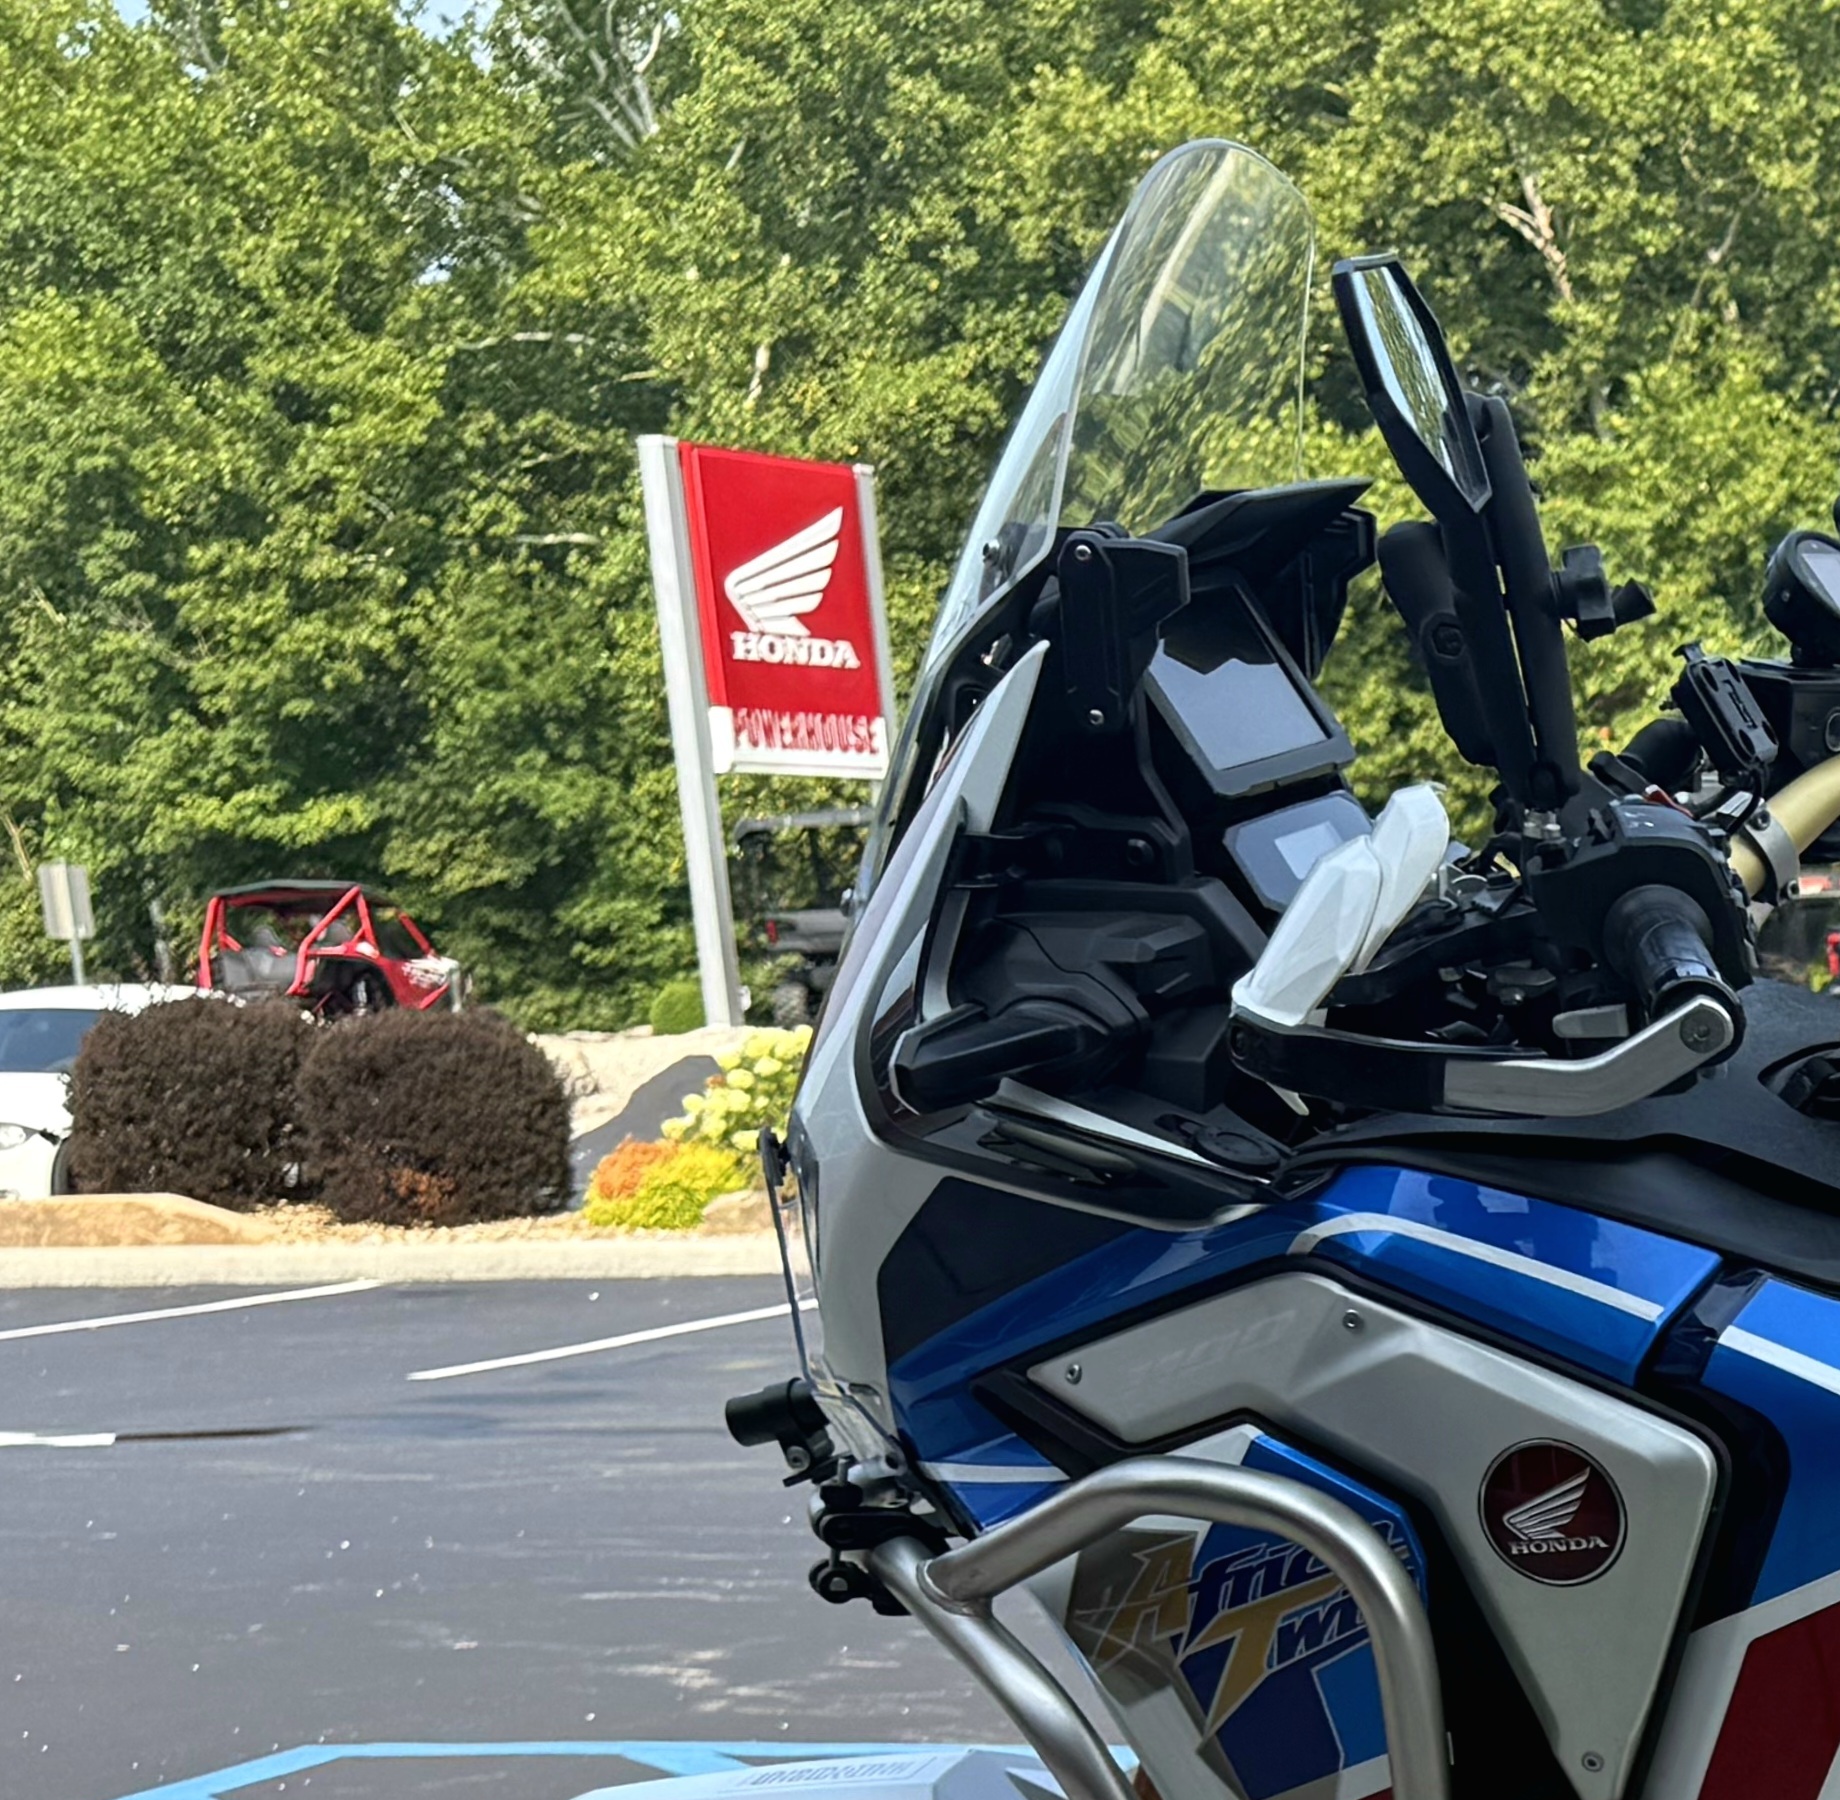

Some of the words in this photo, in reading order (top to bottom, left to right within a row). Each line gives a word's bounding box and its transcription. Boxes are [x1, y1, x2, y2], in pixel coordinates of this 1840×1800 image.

[730, 630, 861, 669] HONDA
[733, 706, 880, 755] POWERHOUSE
[1508, 1535, 1609, 1556] HONDA
[1076, 1530, 1338, 1672] Afric
